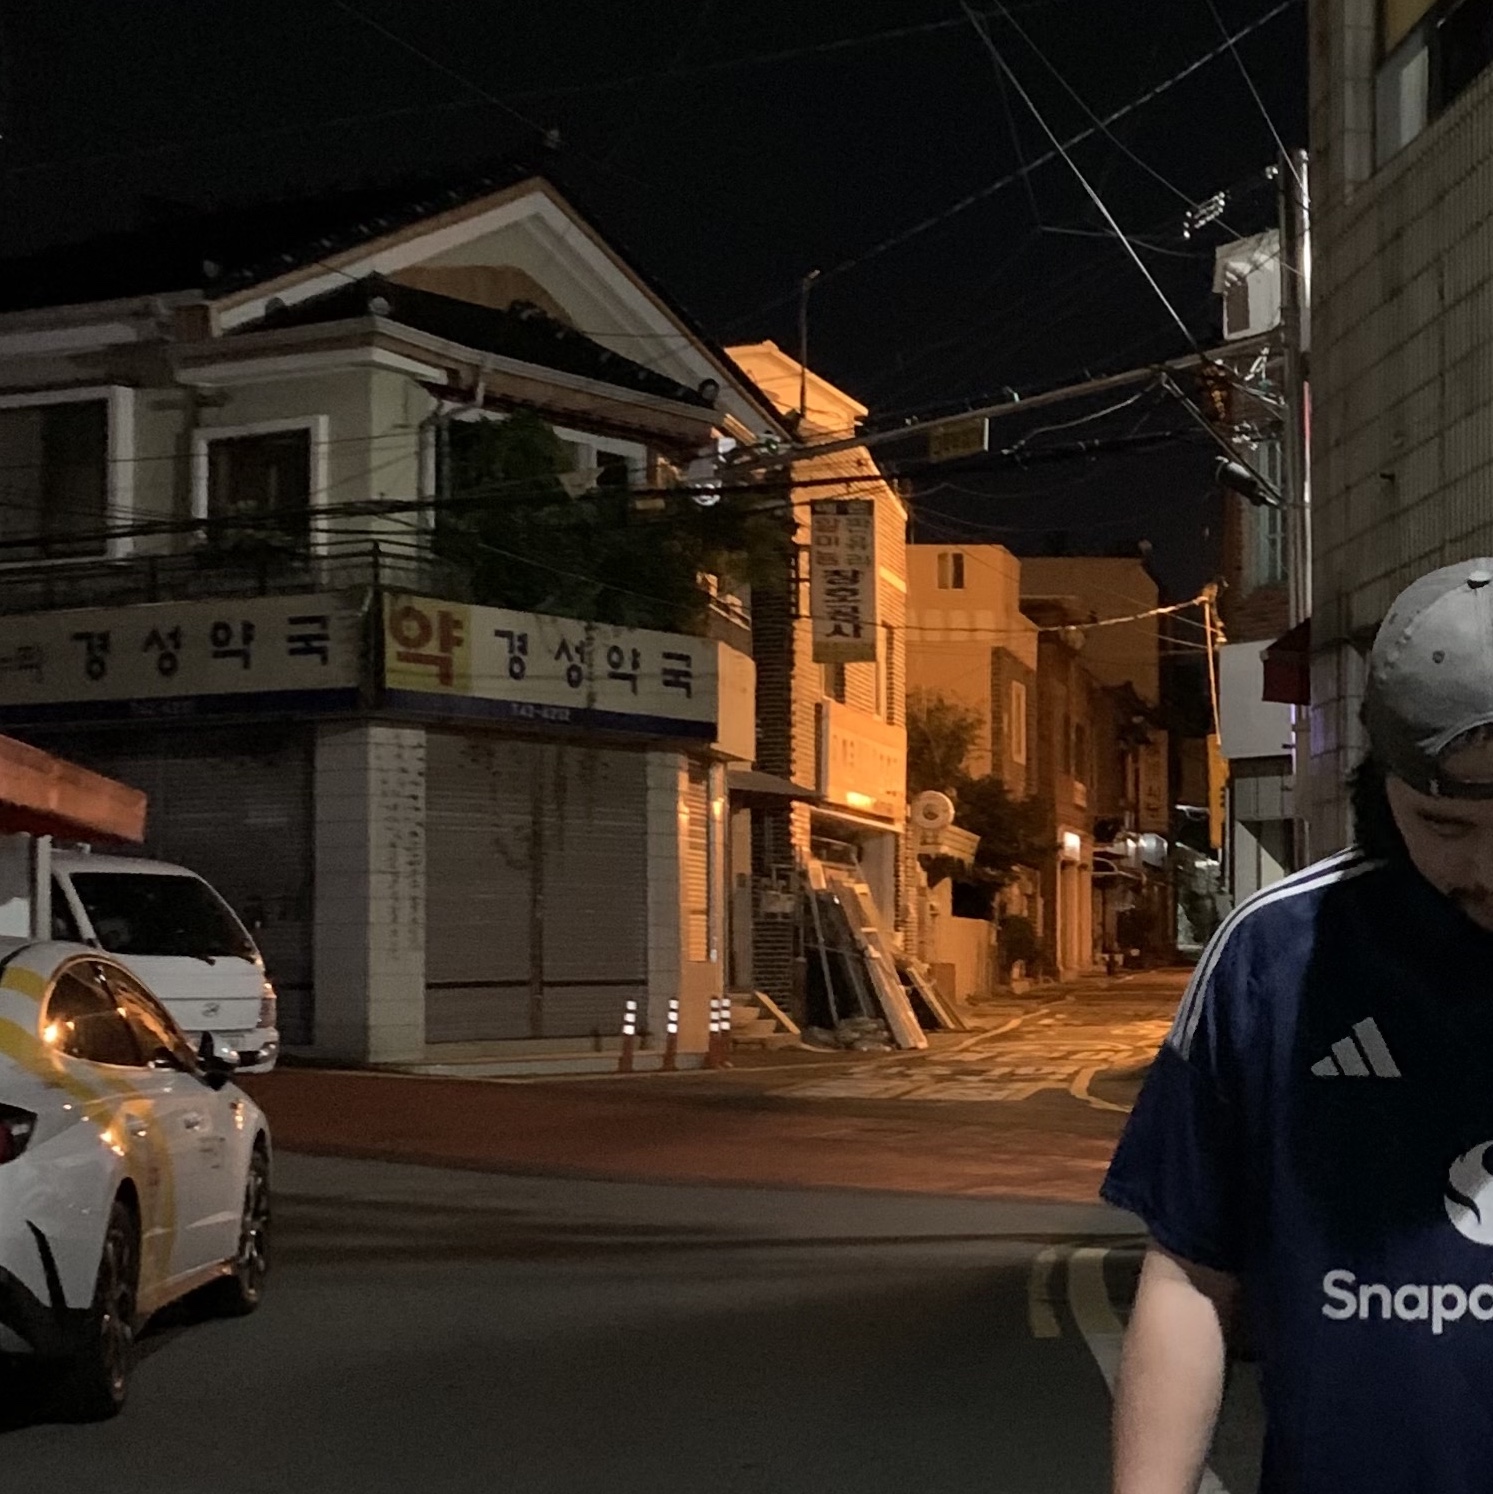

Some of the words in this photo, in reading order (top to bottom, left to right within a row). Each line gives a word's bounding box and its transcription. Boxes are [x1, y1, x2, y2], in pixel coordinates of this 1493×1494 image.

[71, 615, 330, 681] 경성약국
[390, 605, 464, 687] 약
[494, 629, 693, 699] 경성약국
